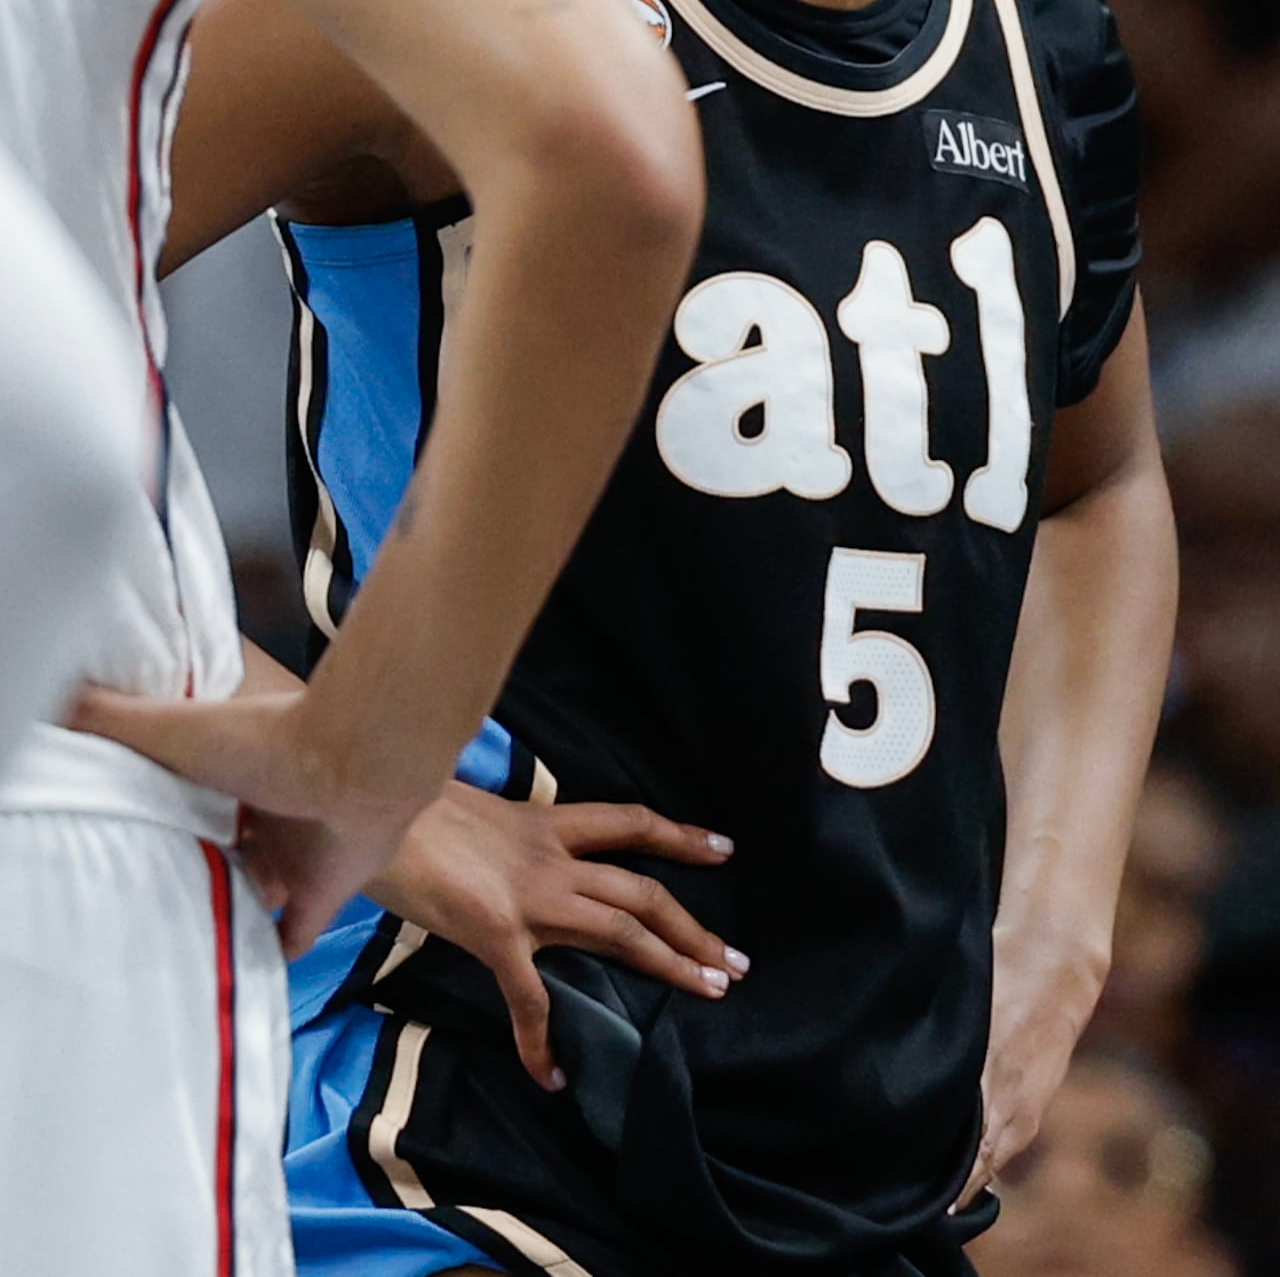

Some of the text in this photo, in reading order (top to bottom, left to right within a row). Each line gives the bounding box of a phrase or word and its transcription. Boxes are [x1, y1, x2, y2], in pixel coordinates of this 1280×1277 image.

[934, 118, 1026, 183] Albert
[656, 216, 1030, 533] atl
[819, 546, 936, 789] 5
